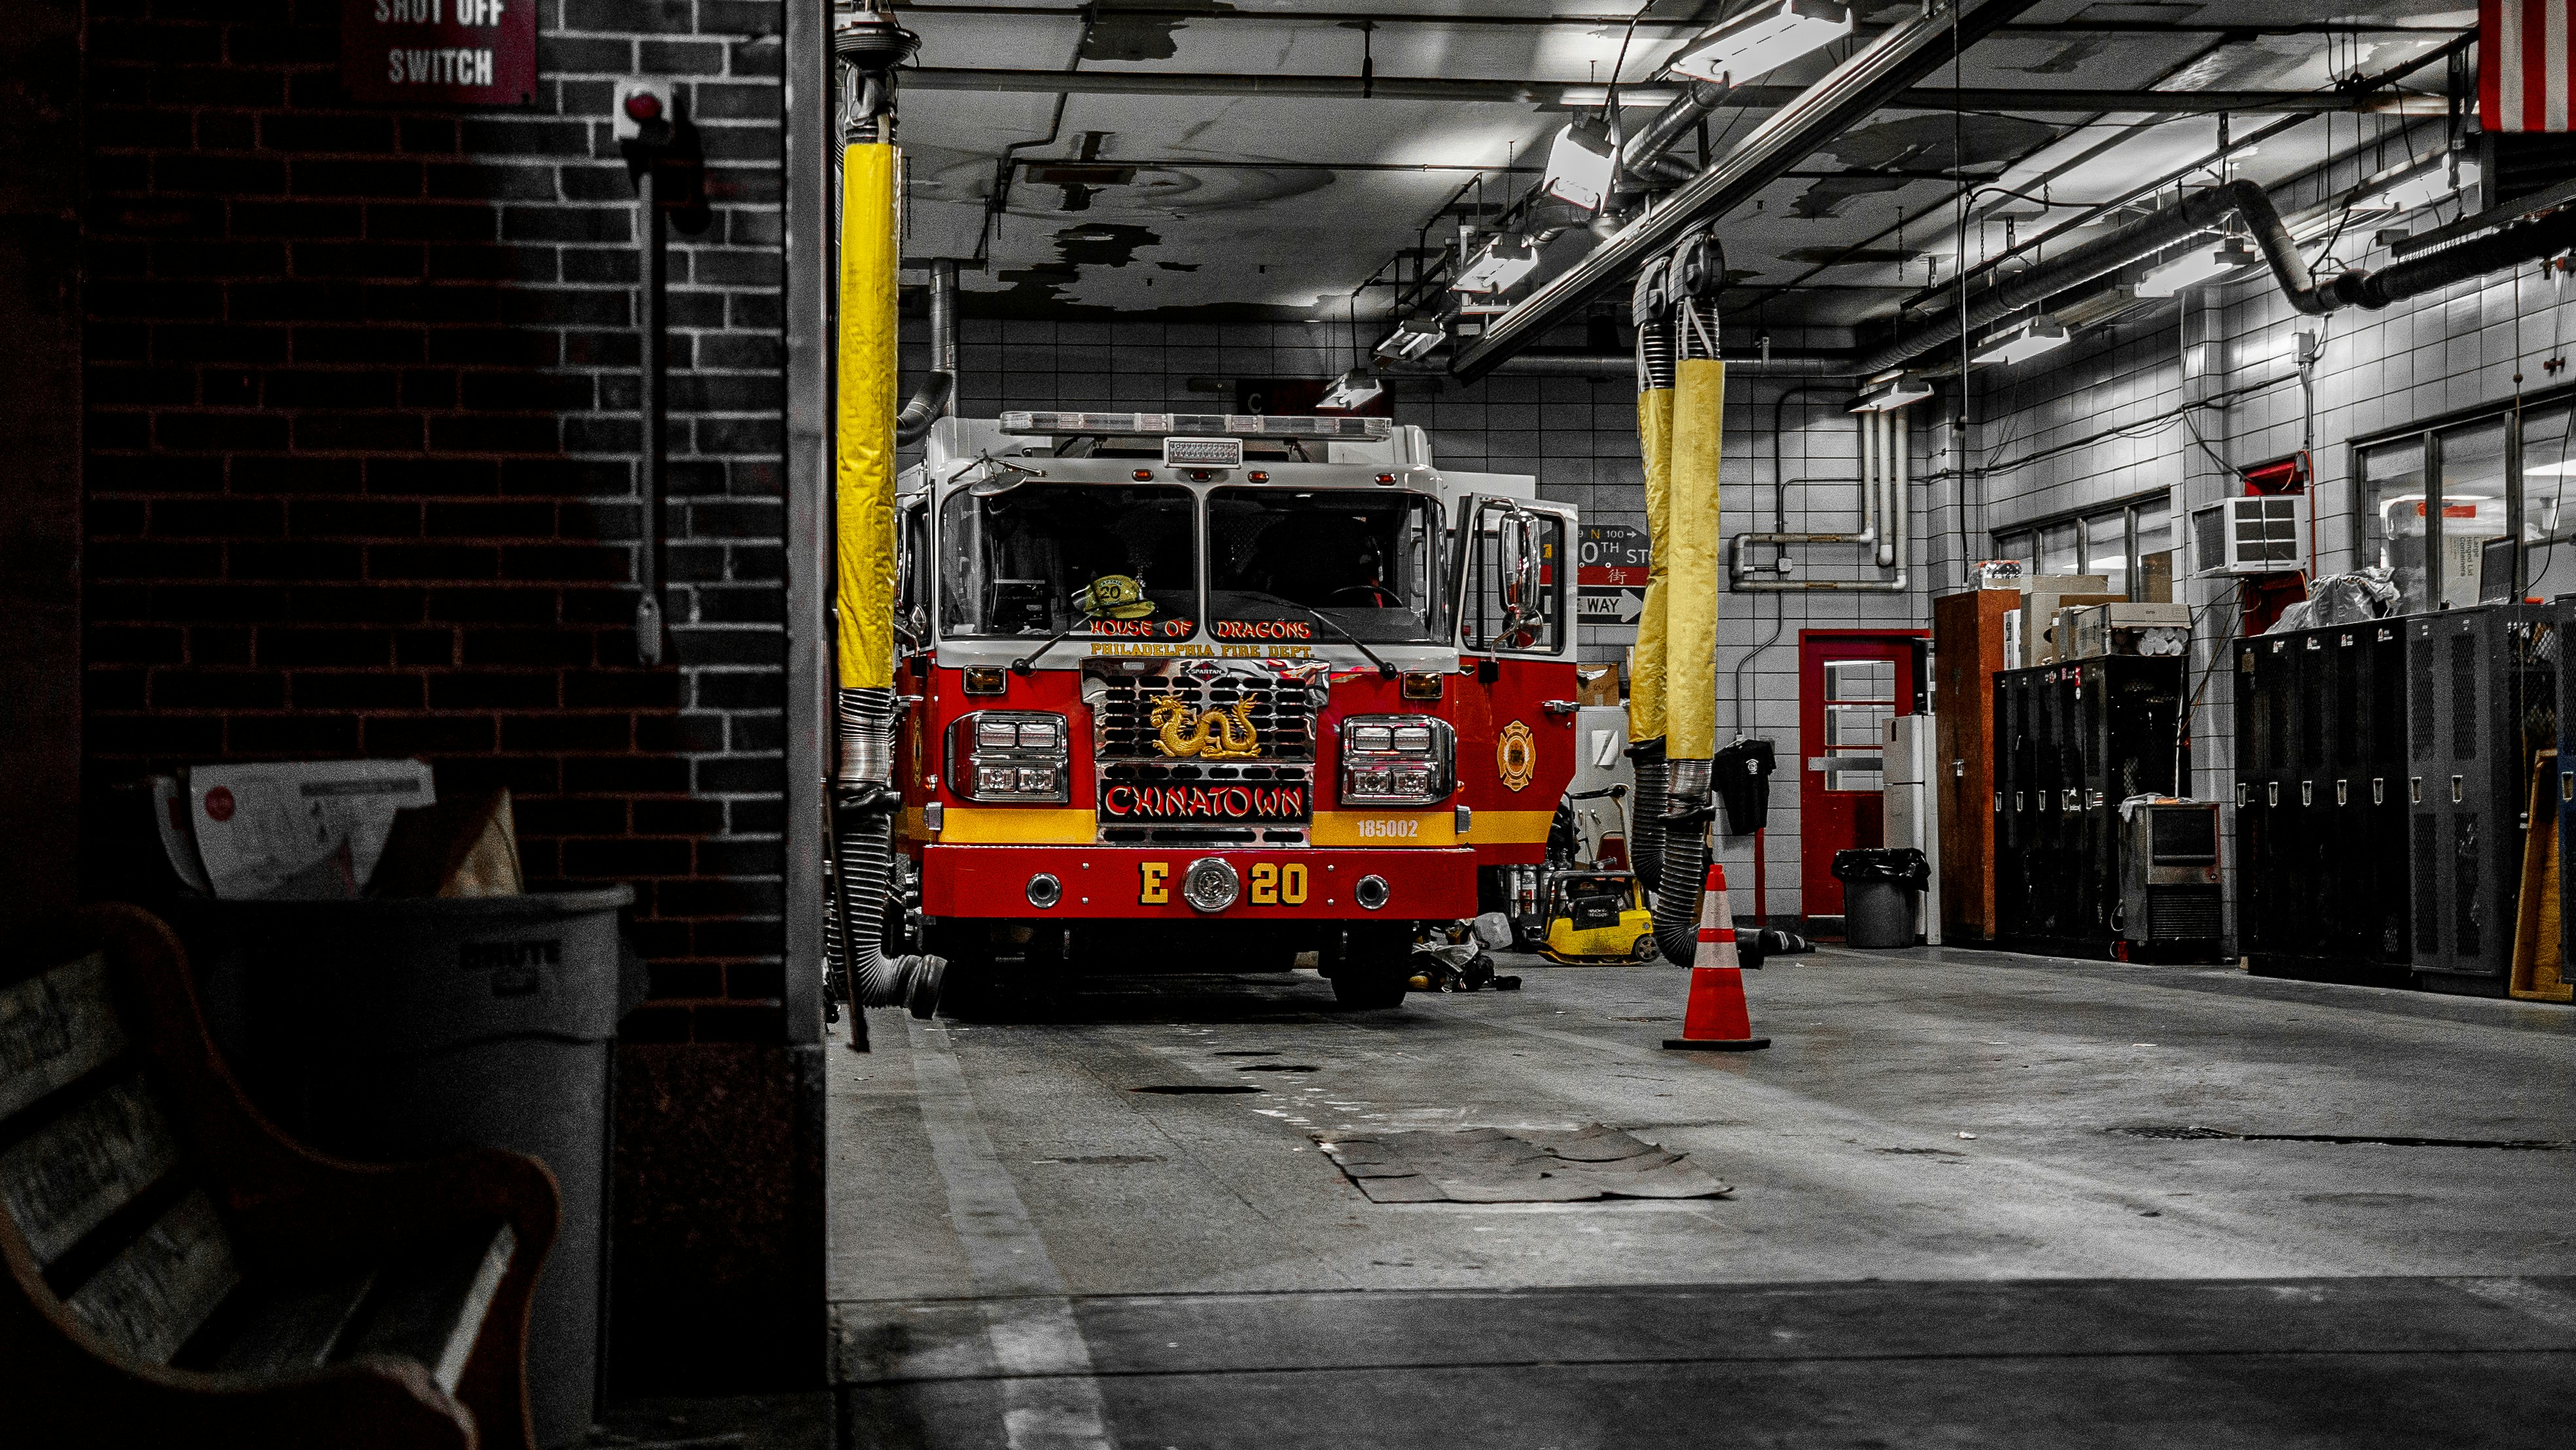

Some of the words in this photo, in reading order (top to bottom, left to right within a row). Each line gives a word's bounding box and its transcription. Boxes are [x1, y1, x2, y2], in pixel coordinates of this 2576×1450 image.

[389, 48, 493, 85] SWITCH
[1591, 529, 1600, 539] N
[1581, 542, 1619, 563] 0TH
[1626, 549, 1649, 563] ST
[1607, 569, 1628, 585] 街
[1100, 586, 1120, 599] 20
[1587, 597, 1620, 613] WAY
[1089, 620, 1153, 637] HOUSE
[1165, 619, 1193, 637] OF
[1217, 620, 1312, 639] DRAGONS
[1090, 643, 1214, 657] PHILADELPHIA
[1221, 644, 1261, 658] FIRE
[1268, 645, 1315, 658] DEPT.
[1105, 786, 1303, 817] CHINATOWN
[1357, 819, 1418, 838] 185002
[1140, 862, 1169, 904] E
[1251, 862, 1308, 904] 20
